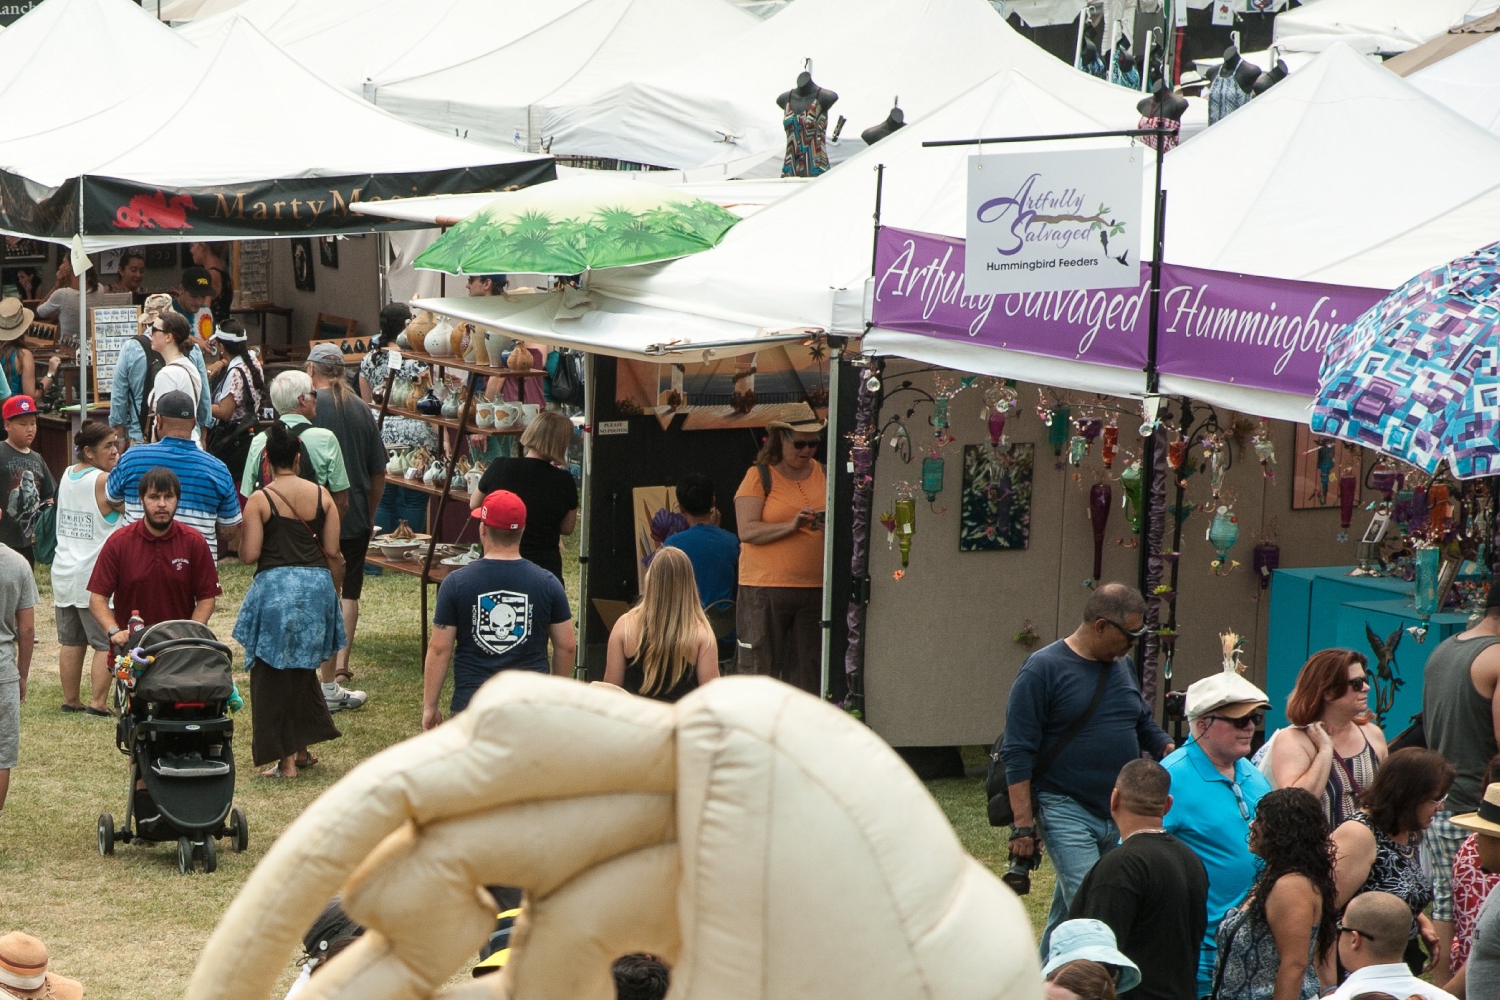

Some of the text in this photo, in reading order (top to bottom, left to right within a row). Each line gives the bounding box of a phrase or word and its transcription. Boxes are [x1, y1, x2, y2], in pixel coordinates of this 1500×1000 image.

[977, 173, 1087, 224] Artfully
[997, 210, 1093, 256] Salvaged
[986, 257, 1099, 271] Hummingbird Feeders
